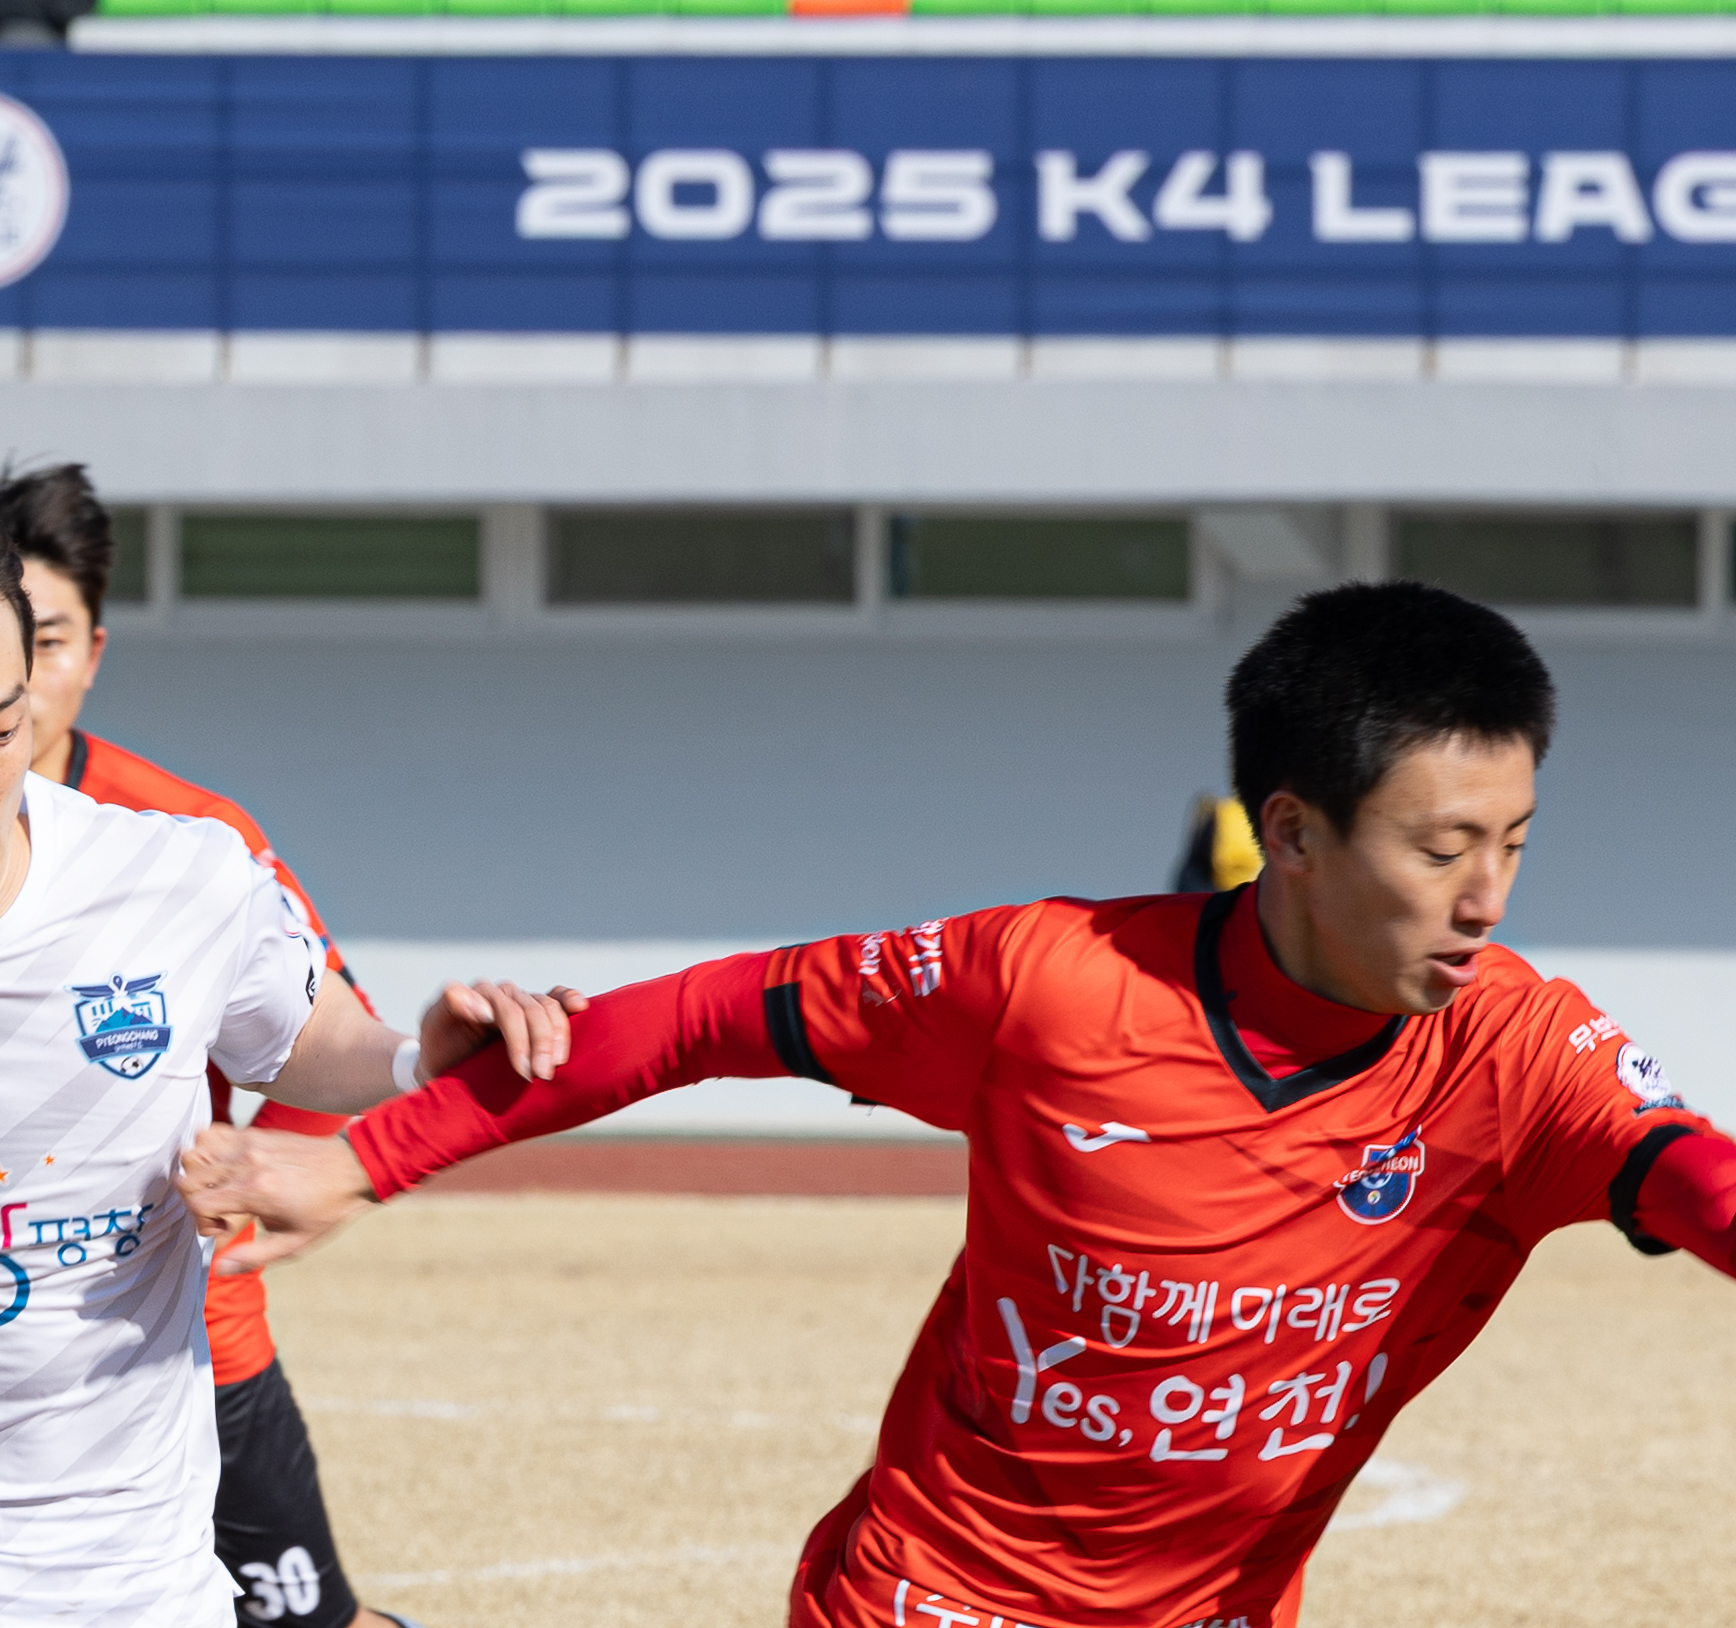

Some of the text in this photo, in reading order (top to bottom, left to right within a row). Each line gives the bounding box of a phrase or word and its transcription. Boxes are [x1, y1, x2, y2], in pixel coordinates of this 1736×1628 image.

[514, 148, 999, 241] 2025
[1036, 149, 1274, 243] K4
[1047, 1243, 1401, 1349] 다함께 미래로
[996, 1297, 1389, 1463] Yes, 연천!
[238, 1546, 321, 1621] 30
